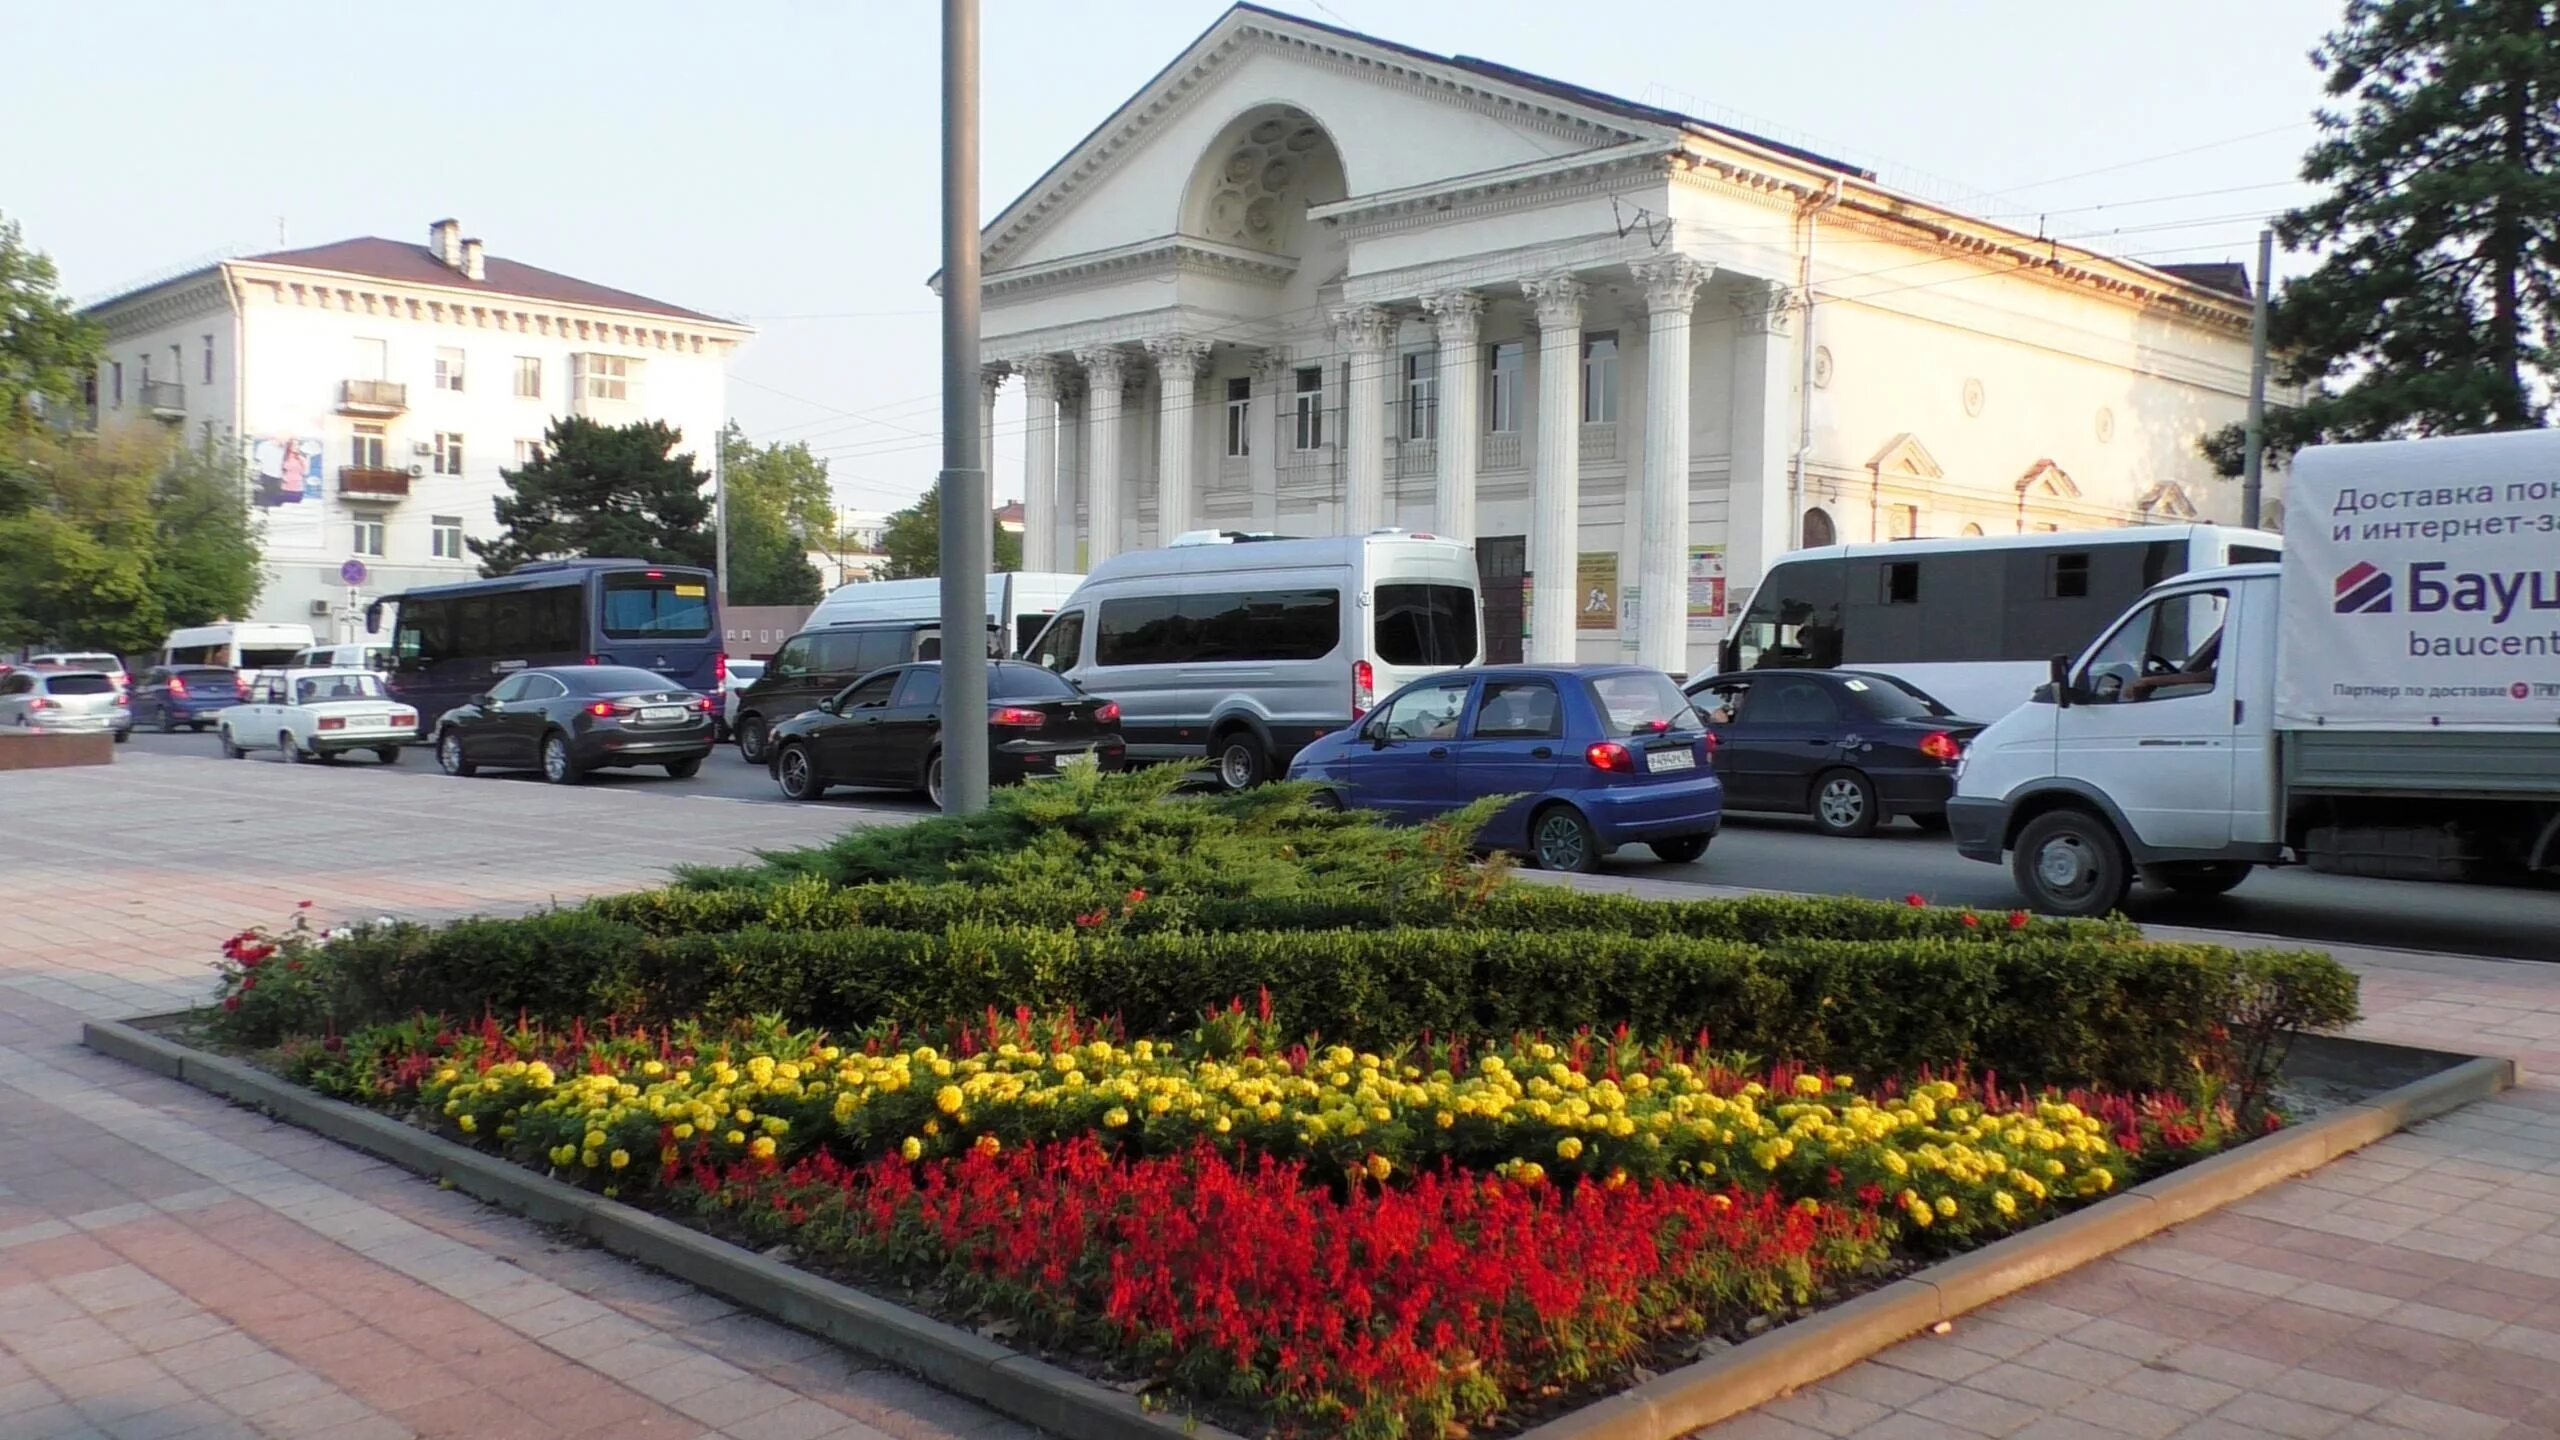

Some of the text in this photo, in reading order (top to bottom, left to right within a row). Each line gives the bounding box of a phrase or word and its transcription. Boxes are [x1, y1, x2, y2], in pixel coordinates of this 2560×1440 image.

[2333, 486, 2493, 517] Доставка
[2333, 514, 2560, 543] и интернет-з
[2409, 630, 2560, 657] baucent
[2333, 683, 2400, 699] Партнер
[2404, 687, 2425, 697] по
